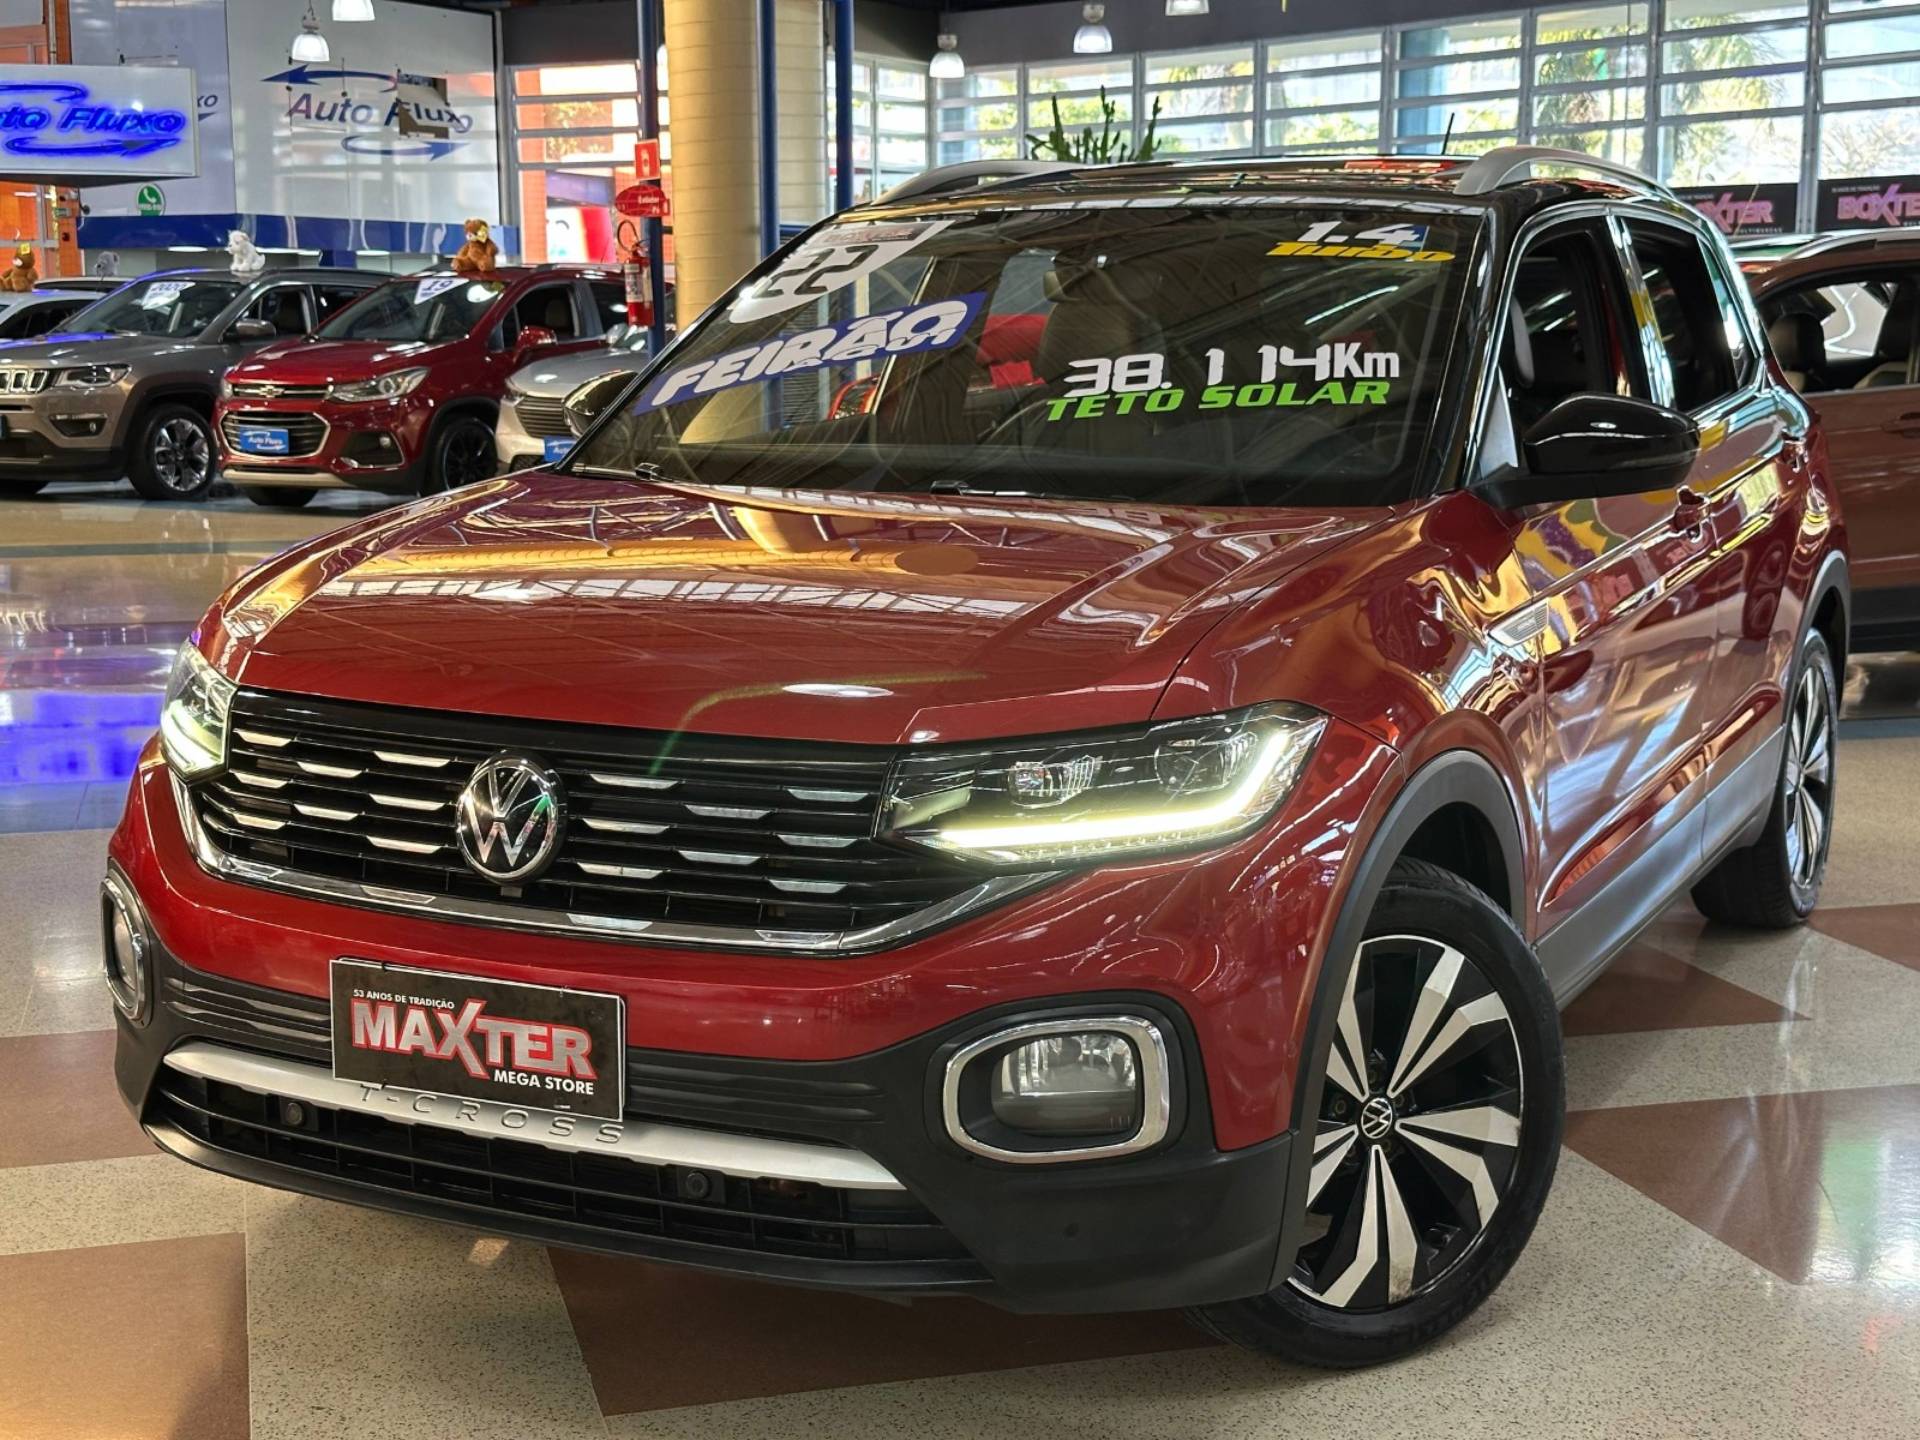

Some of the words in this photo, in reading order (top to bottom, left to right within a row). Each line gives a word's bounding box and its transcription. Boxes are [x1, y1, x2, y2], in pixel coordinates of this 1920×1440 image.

[0, 105, 48, 130] to
[60, 107, 183, 132] Fluxo
[286, 93, 373, 126] Auto
[384, 97, 474, 134] Fluxo
[1837, 183, 1920, 226] BOXTE
[1297, 221, 1420, 245] 1.4
[751, 244, 880, 298] 22
[1046, 389, 1185, 421] TETO
[1198, 381, 1391, 410] SOLAR
[366, 990, 392, 1002] ANOS
[394, 994, 408, 1004] DE
[409, 996, 456, 1010] TRADIÇÃO
[351, 999, 598, 1080] MAXTER
[493, 1069, 542, 1089] MEGA
[545, 1076, 595, 1096] STORE
[359, 1083, 626, 1144] T-CROSS
